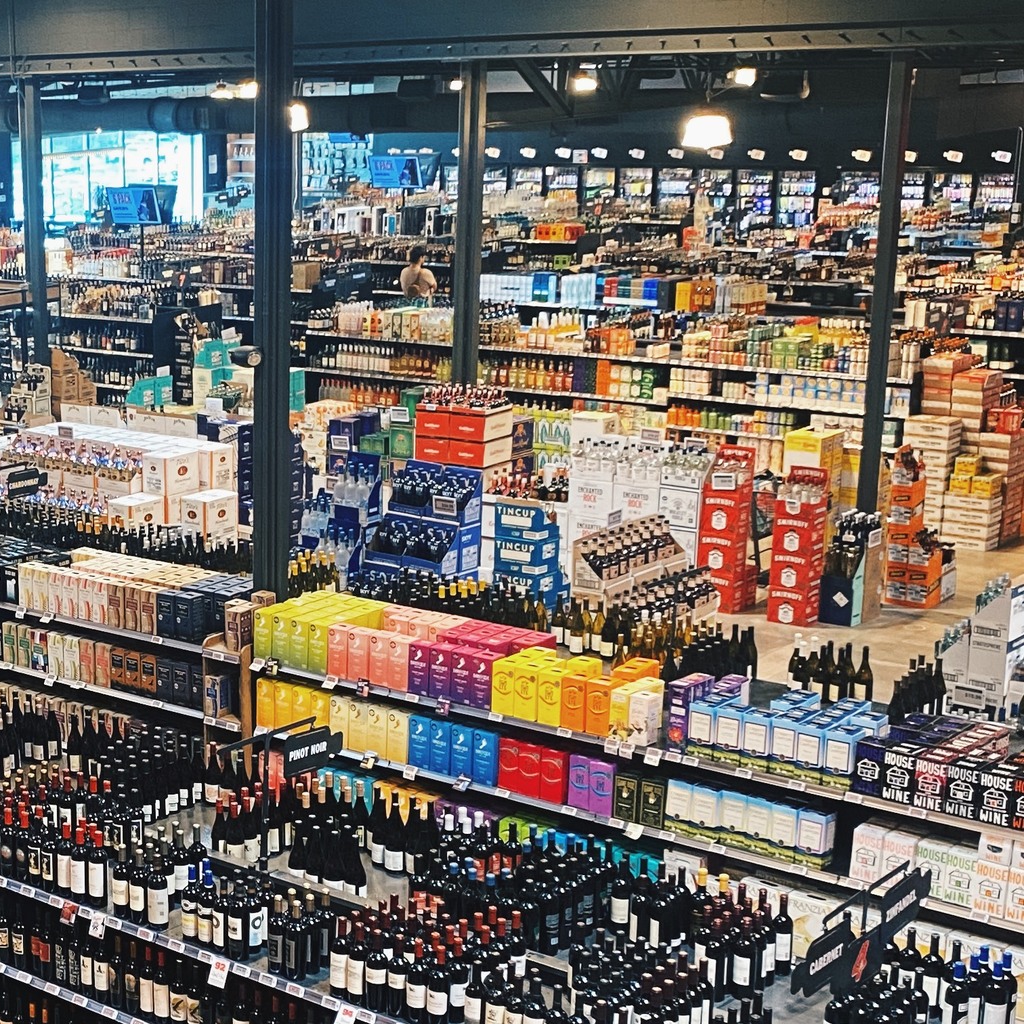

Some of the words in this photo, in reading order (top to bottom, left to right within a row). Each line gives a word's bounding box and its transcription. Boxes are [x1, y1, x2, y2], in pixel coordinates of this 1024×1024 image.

[705, 497, 735, 507] SMIRNOFF
[496, 506, 536, 518] TINCUP
[777, 518, 809, 528] SMIRNOFF
[496, 540, 535, 552] TINCUP
[702, 536, 732, 547] SMIRNOFF
[774, 554, 806, 565] SMIRNOFF
[495, 573, 533, 587] TNCUP
[772, 590, 803, 601] SMIRNOFF
[289, 746, 310, 762] PINOT
[310, 741, 328, 755] NOIR
[884, 751, 914, 770] HOUSE
[916, 759, 947, 778] HOUSE
[948, 765, 979, 783] HOUSE
[981, 773, 1014, 792] HOUSE
[882, 786, 911, 804] WINE
[913, 794, 942, 812] WINE
[946, 801, 975, 819] WINE
[979, 809, 1009, 826] WINE
[854, 832, 882, 850] HOUSE
[884, 839, 914, 856] HOUSE
[917, 846, 947, 864] HOUSE
[947, 855, 977, 871] HOUSE
[852, 867, 878, 881] WINE
[977, 862, 1009, 881] HOUSE
[944, 889, 972, 905] WINE
[974, 898, 1002, 915] WINE
[214, 961, 226, 972] 92
[809, 943, 844, 976] CABERNET
[851, 939, 870, 983] 4
